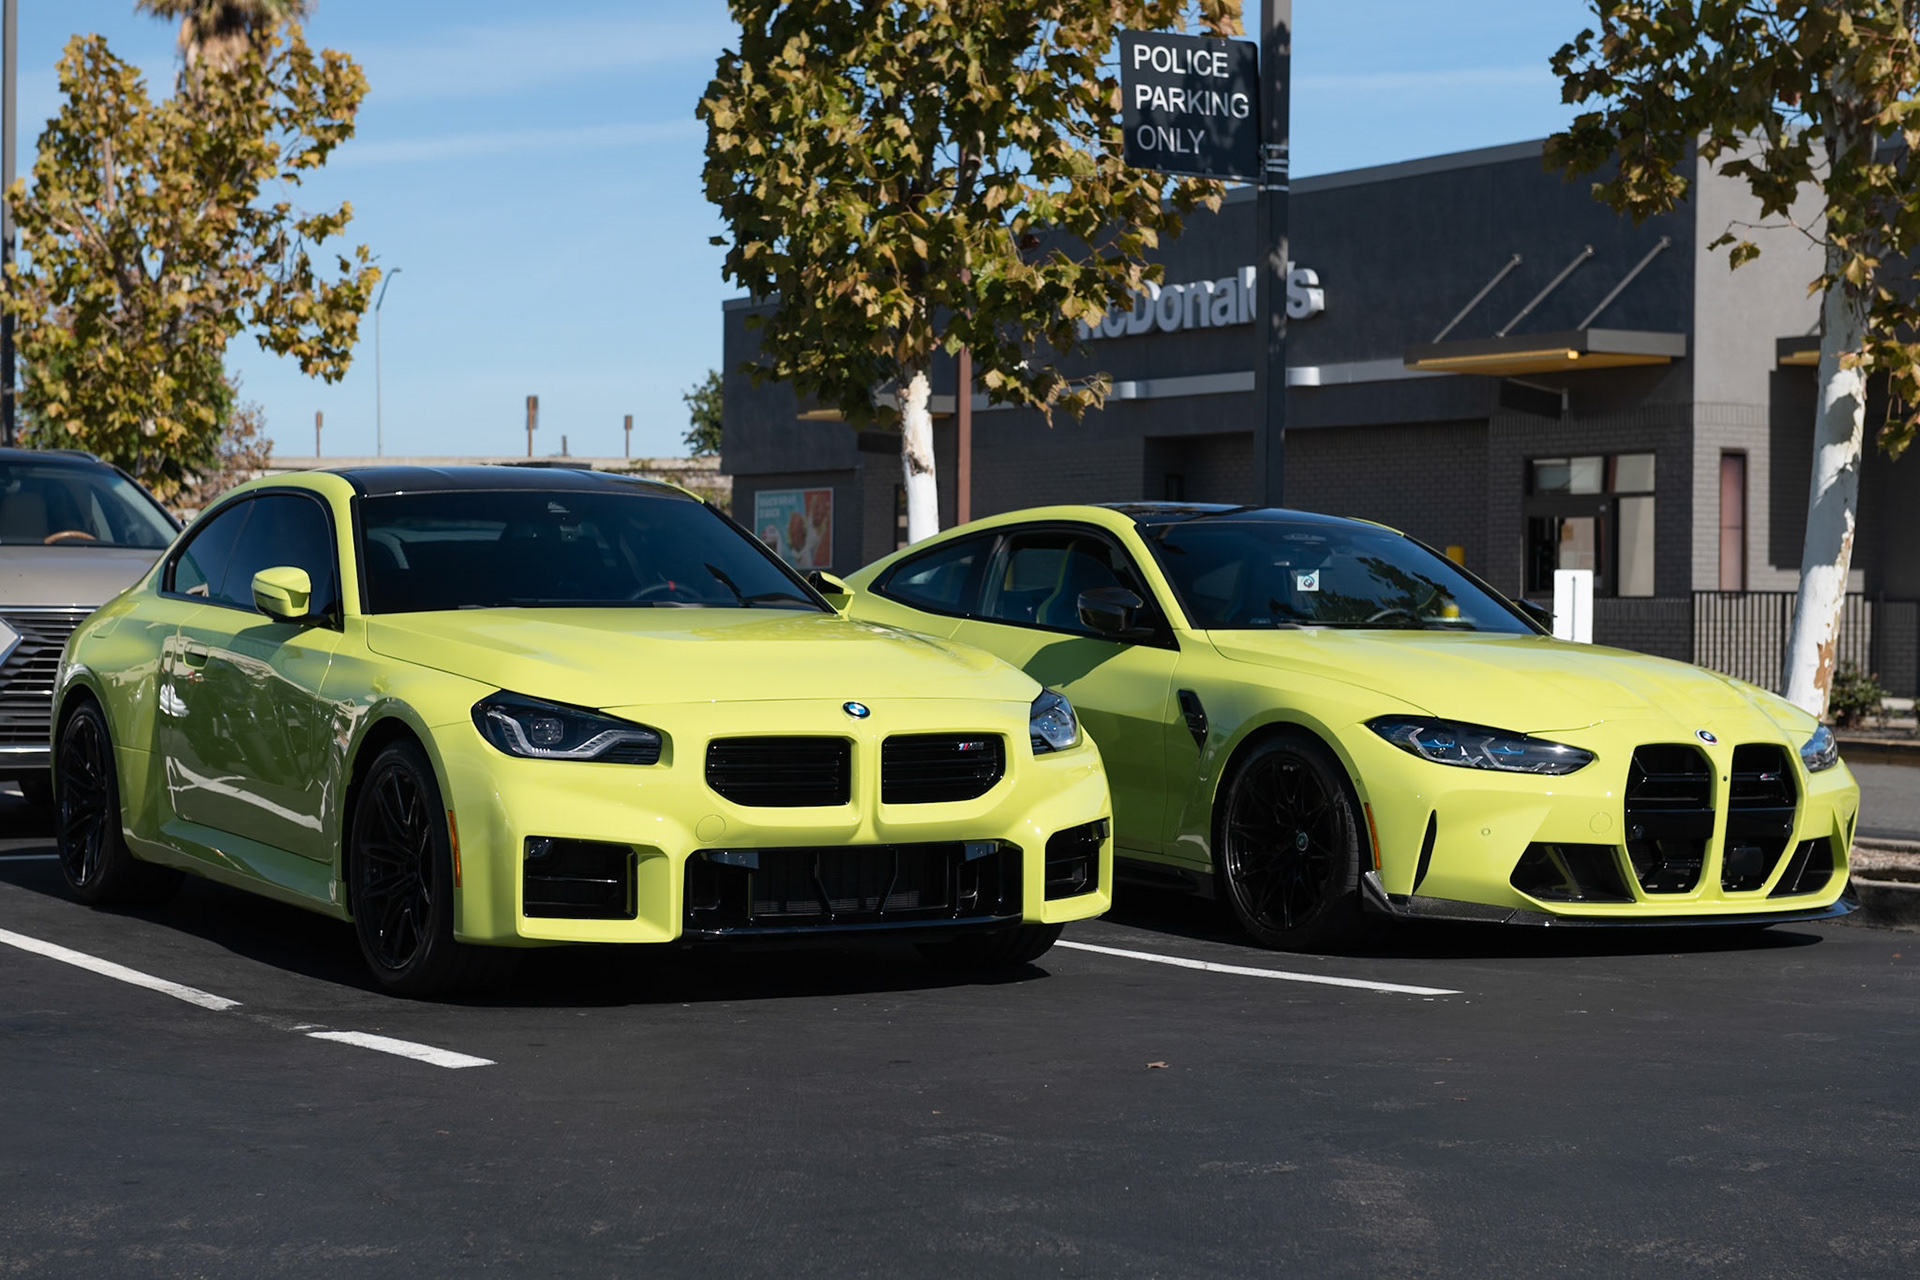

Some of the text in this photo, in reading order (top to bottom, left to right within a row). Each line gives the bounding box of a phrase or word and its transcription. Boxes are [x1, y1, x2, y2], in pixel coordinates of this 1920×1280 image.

[1133, 44, 1229, 78] POLICE
[1135, 84, 1249, 119] PARKING
[1136, 124, 1205, 154] ONLY
[1078, 261, 1325, 339] cDonals
